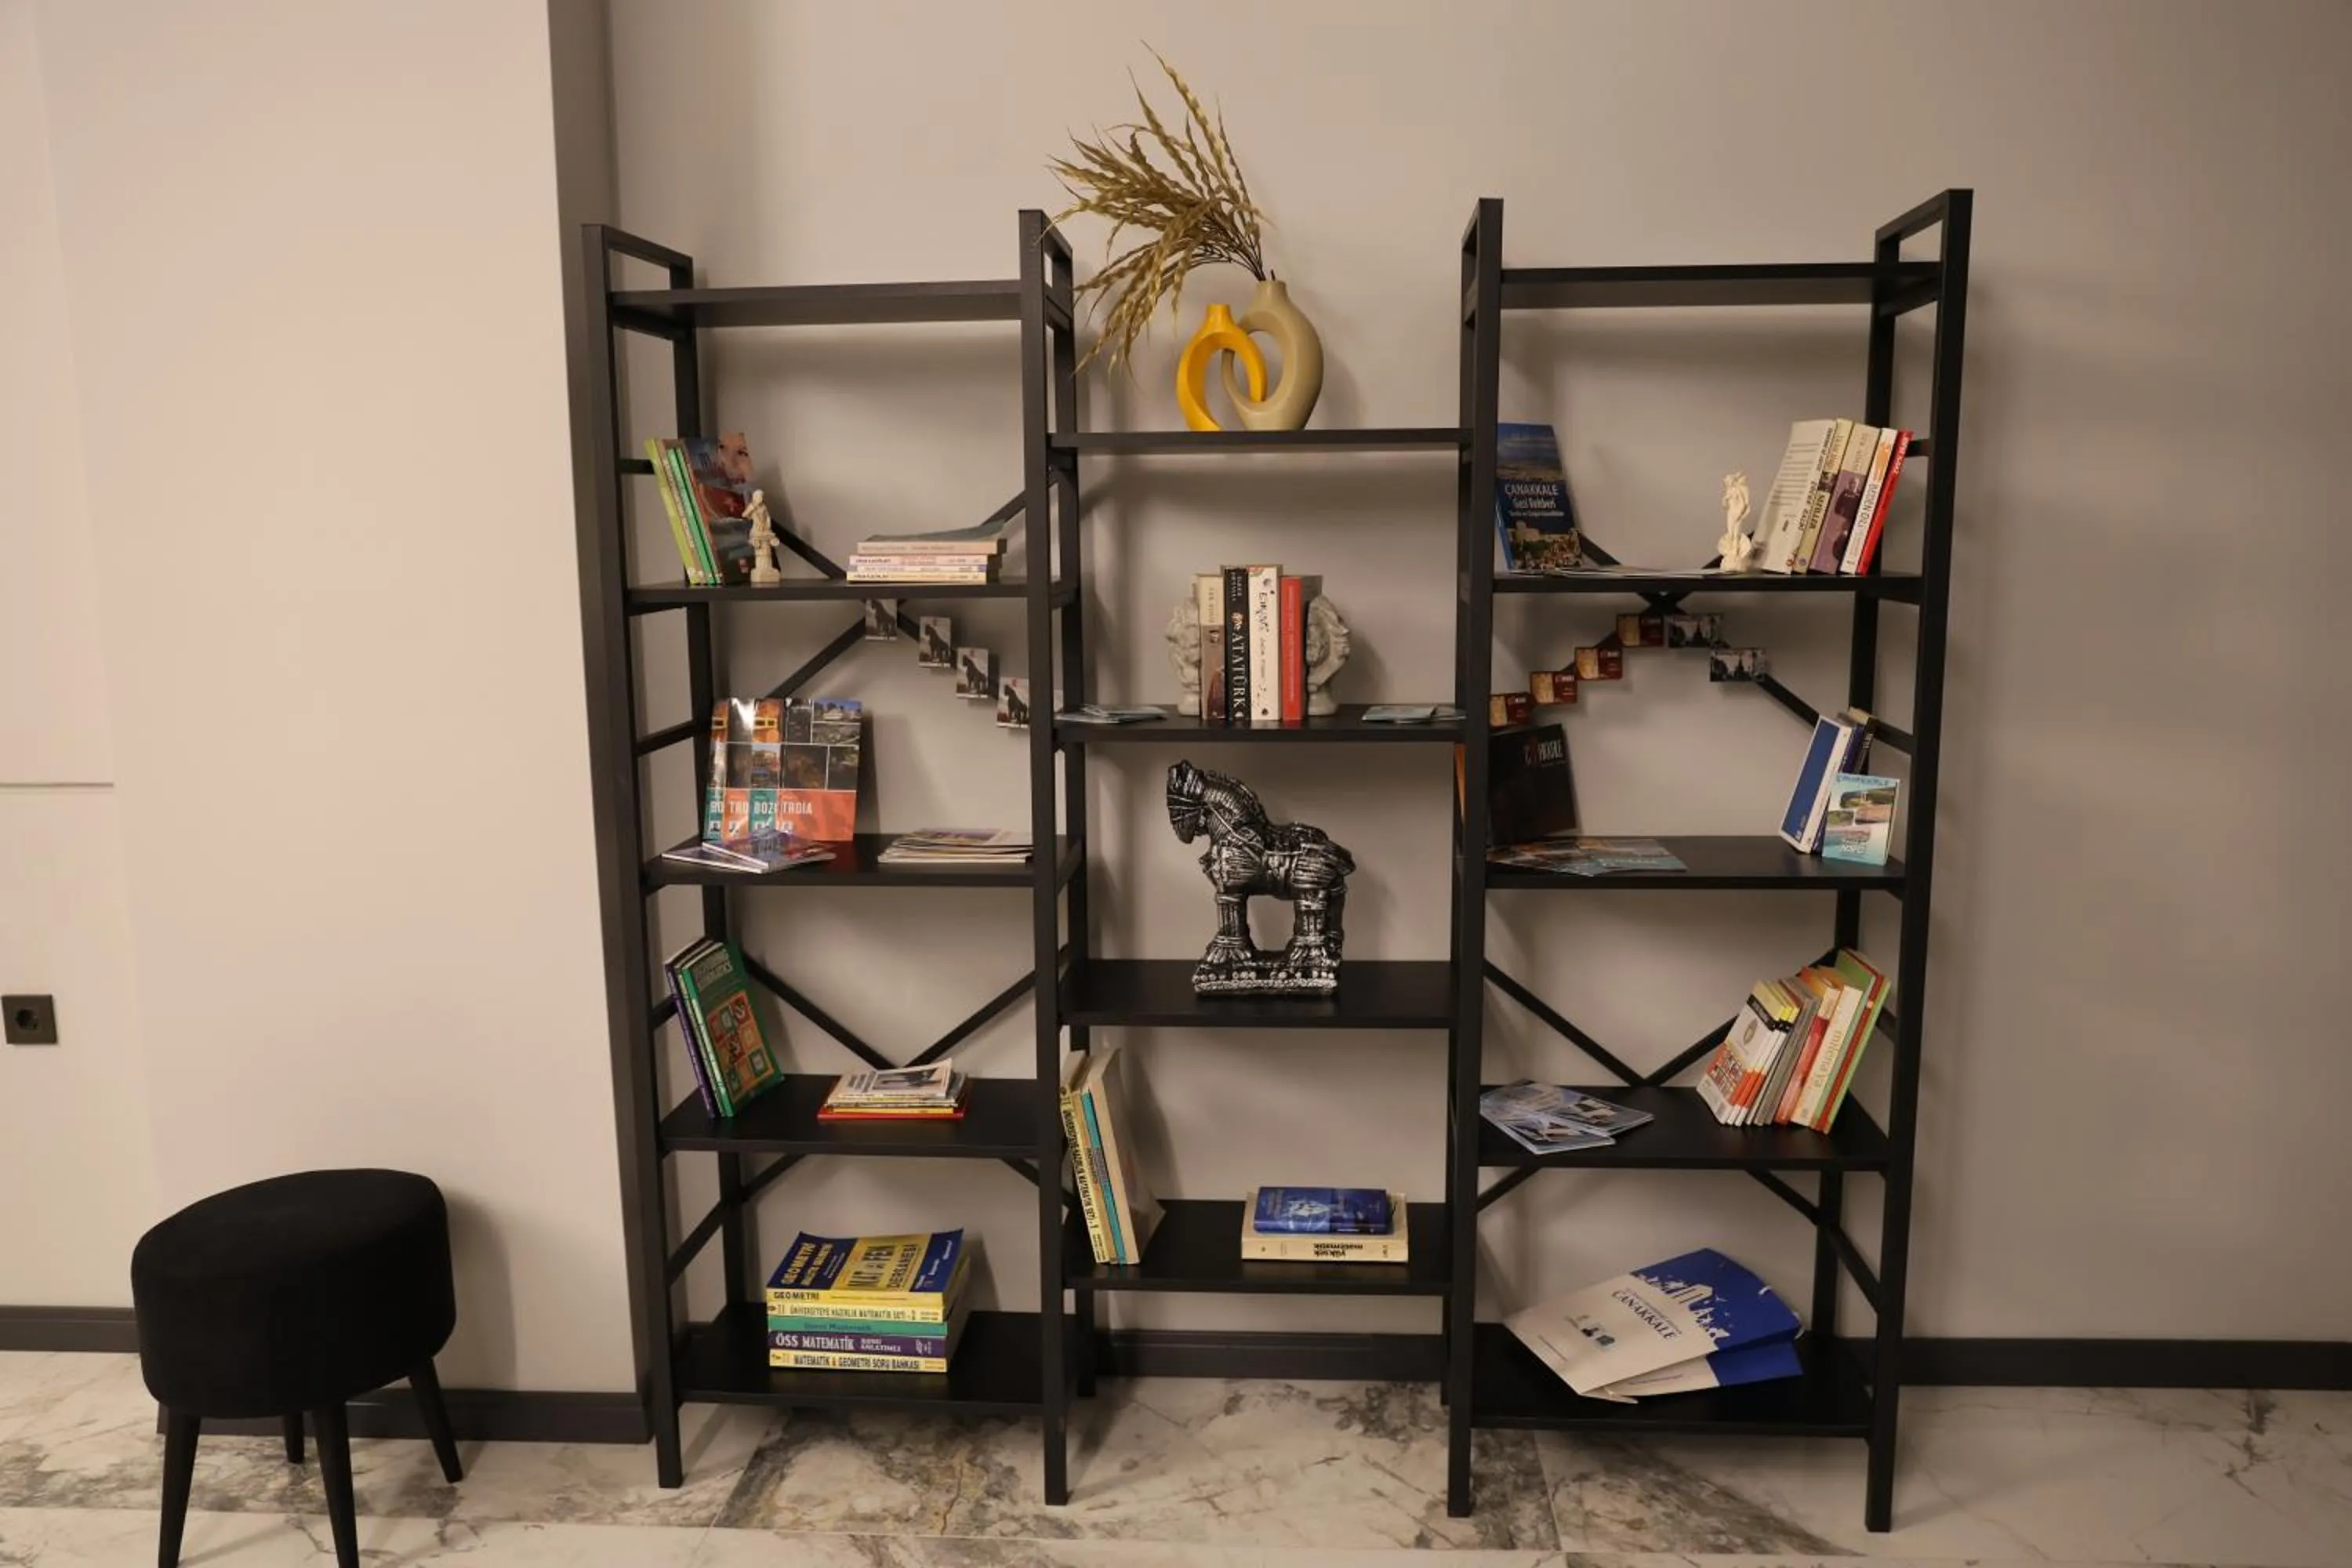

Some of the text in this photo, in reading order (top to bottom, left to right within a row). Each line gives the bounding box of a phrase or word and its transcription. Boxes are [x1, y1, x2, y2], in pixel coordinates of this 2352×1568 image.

[1231, 632, 1246, 708] ATATÜRK
[774, 1291, 819, 1301] GEOMETRİ
[775, 1333, 798, 1347] ÖSS
[802, 1335, 854, 1351] MATEMATİK
